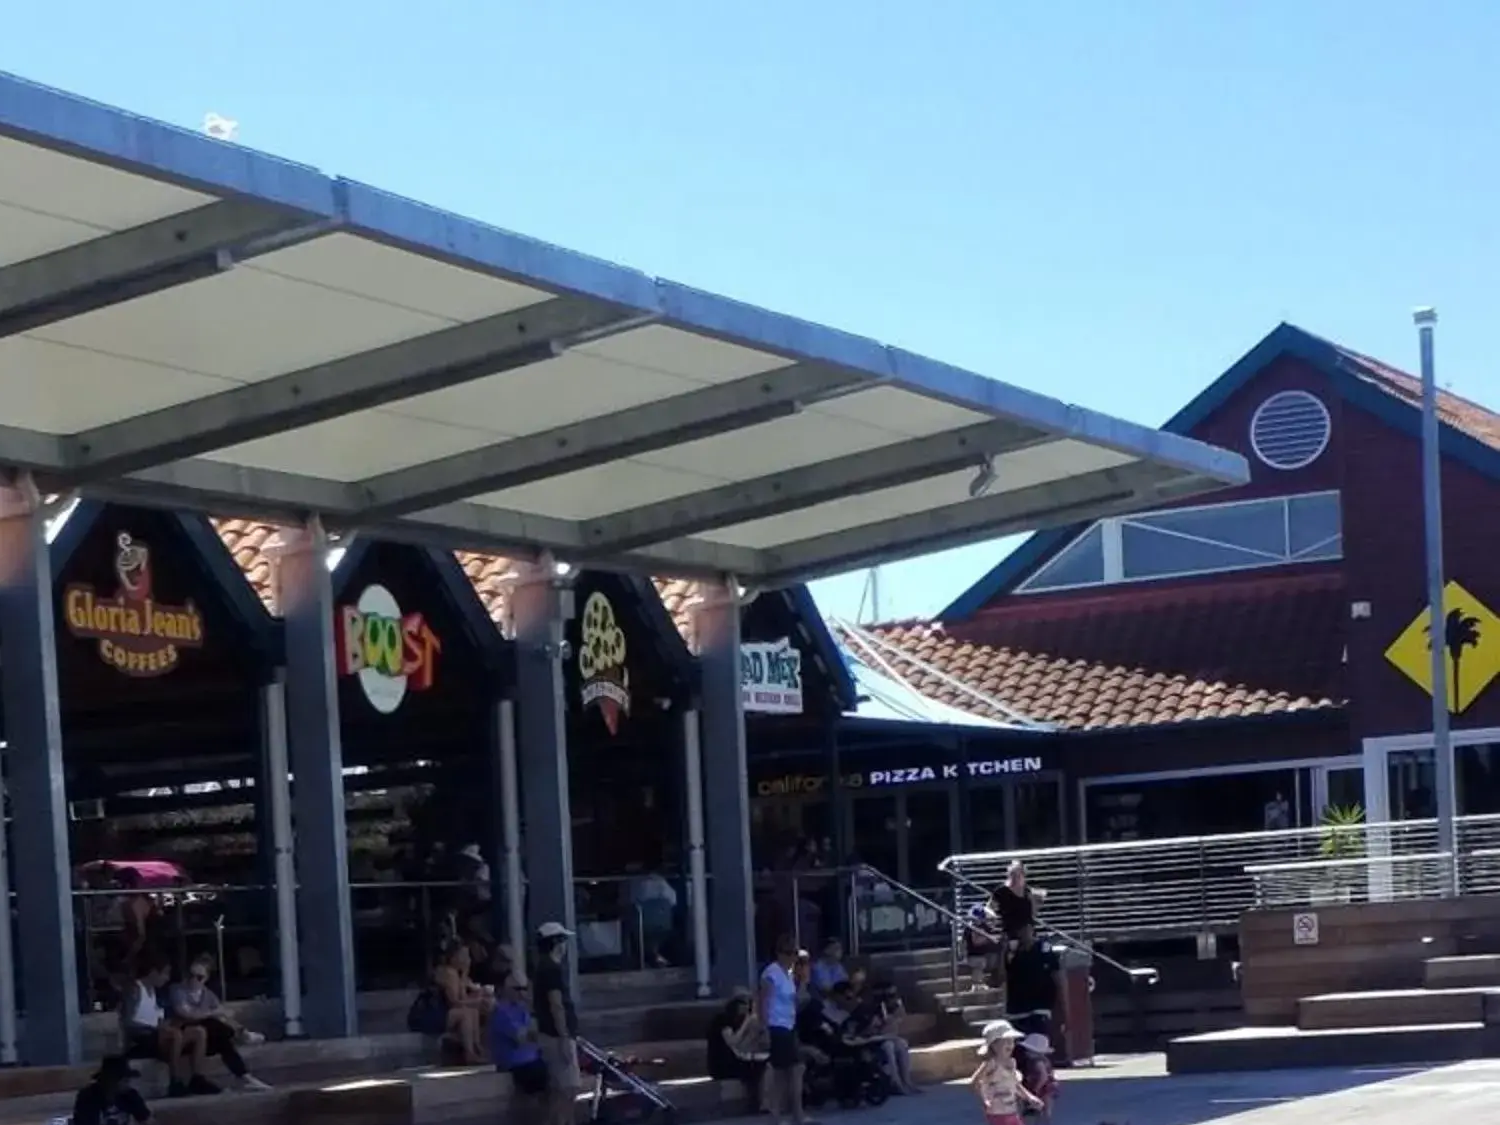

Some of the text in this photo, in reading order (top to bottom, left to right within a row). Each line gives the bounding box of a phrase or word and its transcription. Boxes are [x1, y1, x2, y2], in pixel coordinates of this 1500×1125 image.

[67, 589, 202, 641] Gloria Jean's
[101, 639, 178, 671] COFFEES
[343, 605, 441, 687] BOOST
[869, 767, 936, 785] PIZZA
[942, 756, 1042, 779] KTCHEN
